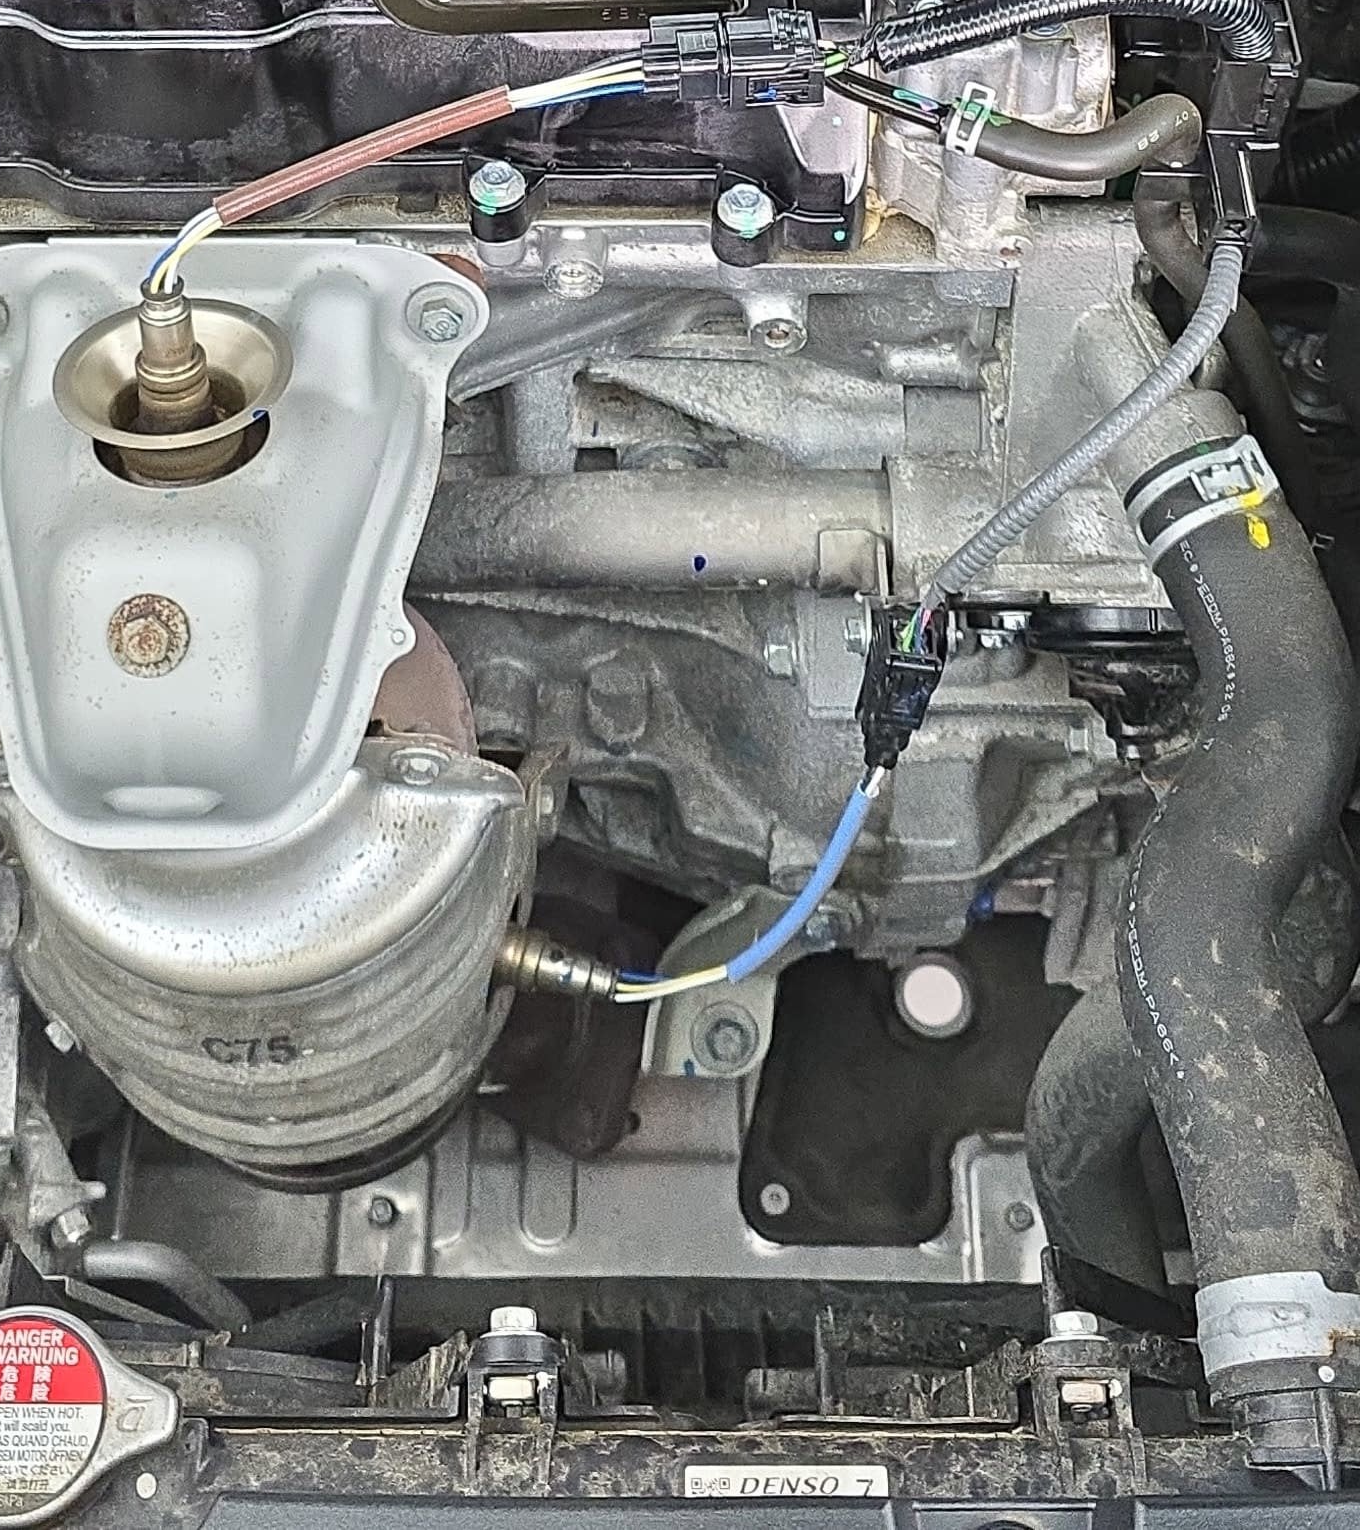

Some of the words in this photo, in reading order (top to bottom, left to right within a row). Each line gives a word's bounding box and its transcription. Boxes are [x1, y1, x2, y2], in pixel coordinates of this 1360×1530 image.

[22, 1406, 56, 1419] WHEN
[11, 1434, 50, 1447] QUAND
[739, 1476, 840, 1496] DENSO
